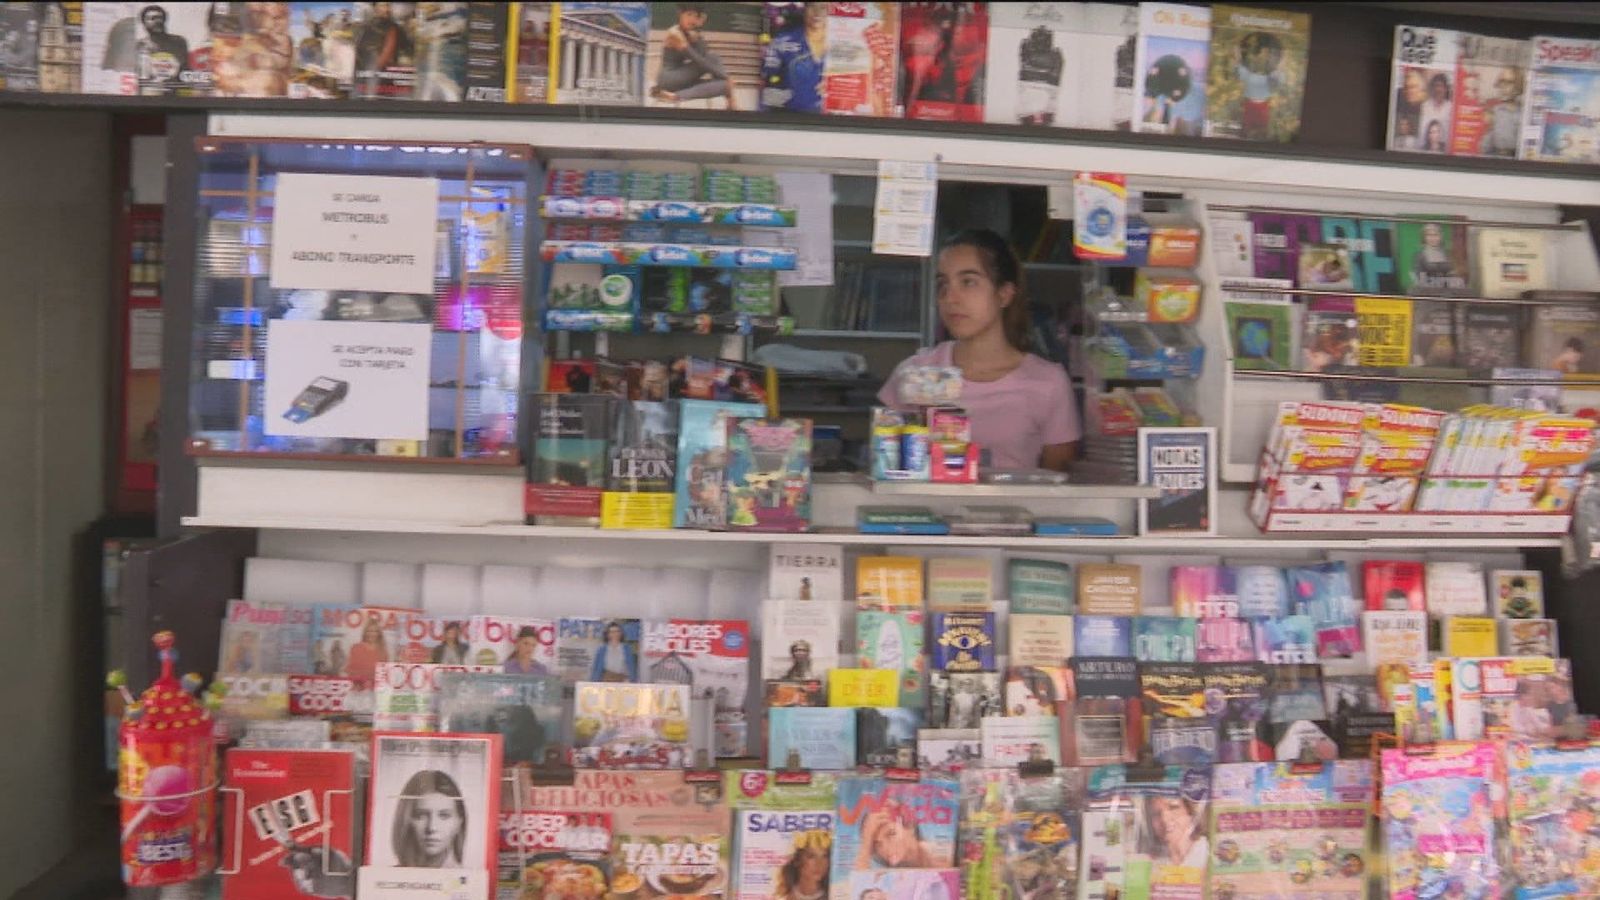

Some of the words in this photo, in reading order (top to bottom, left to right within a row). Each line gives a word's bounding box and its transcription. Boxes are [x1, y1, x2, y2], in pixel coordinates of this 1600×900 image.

[321, 213, 388, 224] METROBUS
[338, 253, 416, 266] TRANSPORTE
[776, 554, 839, 568] TIERRA
[748, 813, 832, 833] SABER
[620, 843, 720, 865] TAPAS
